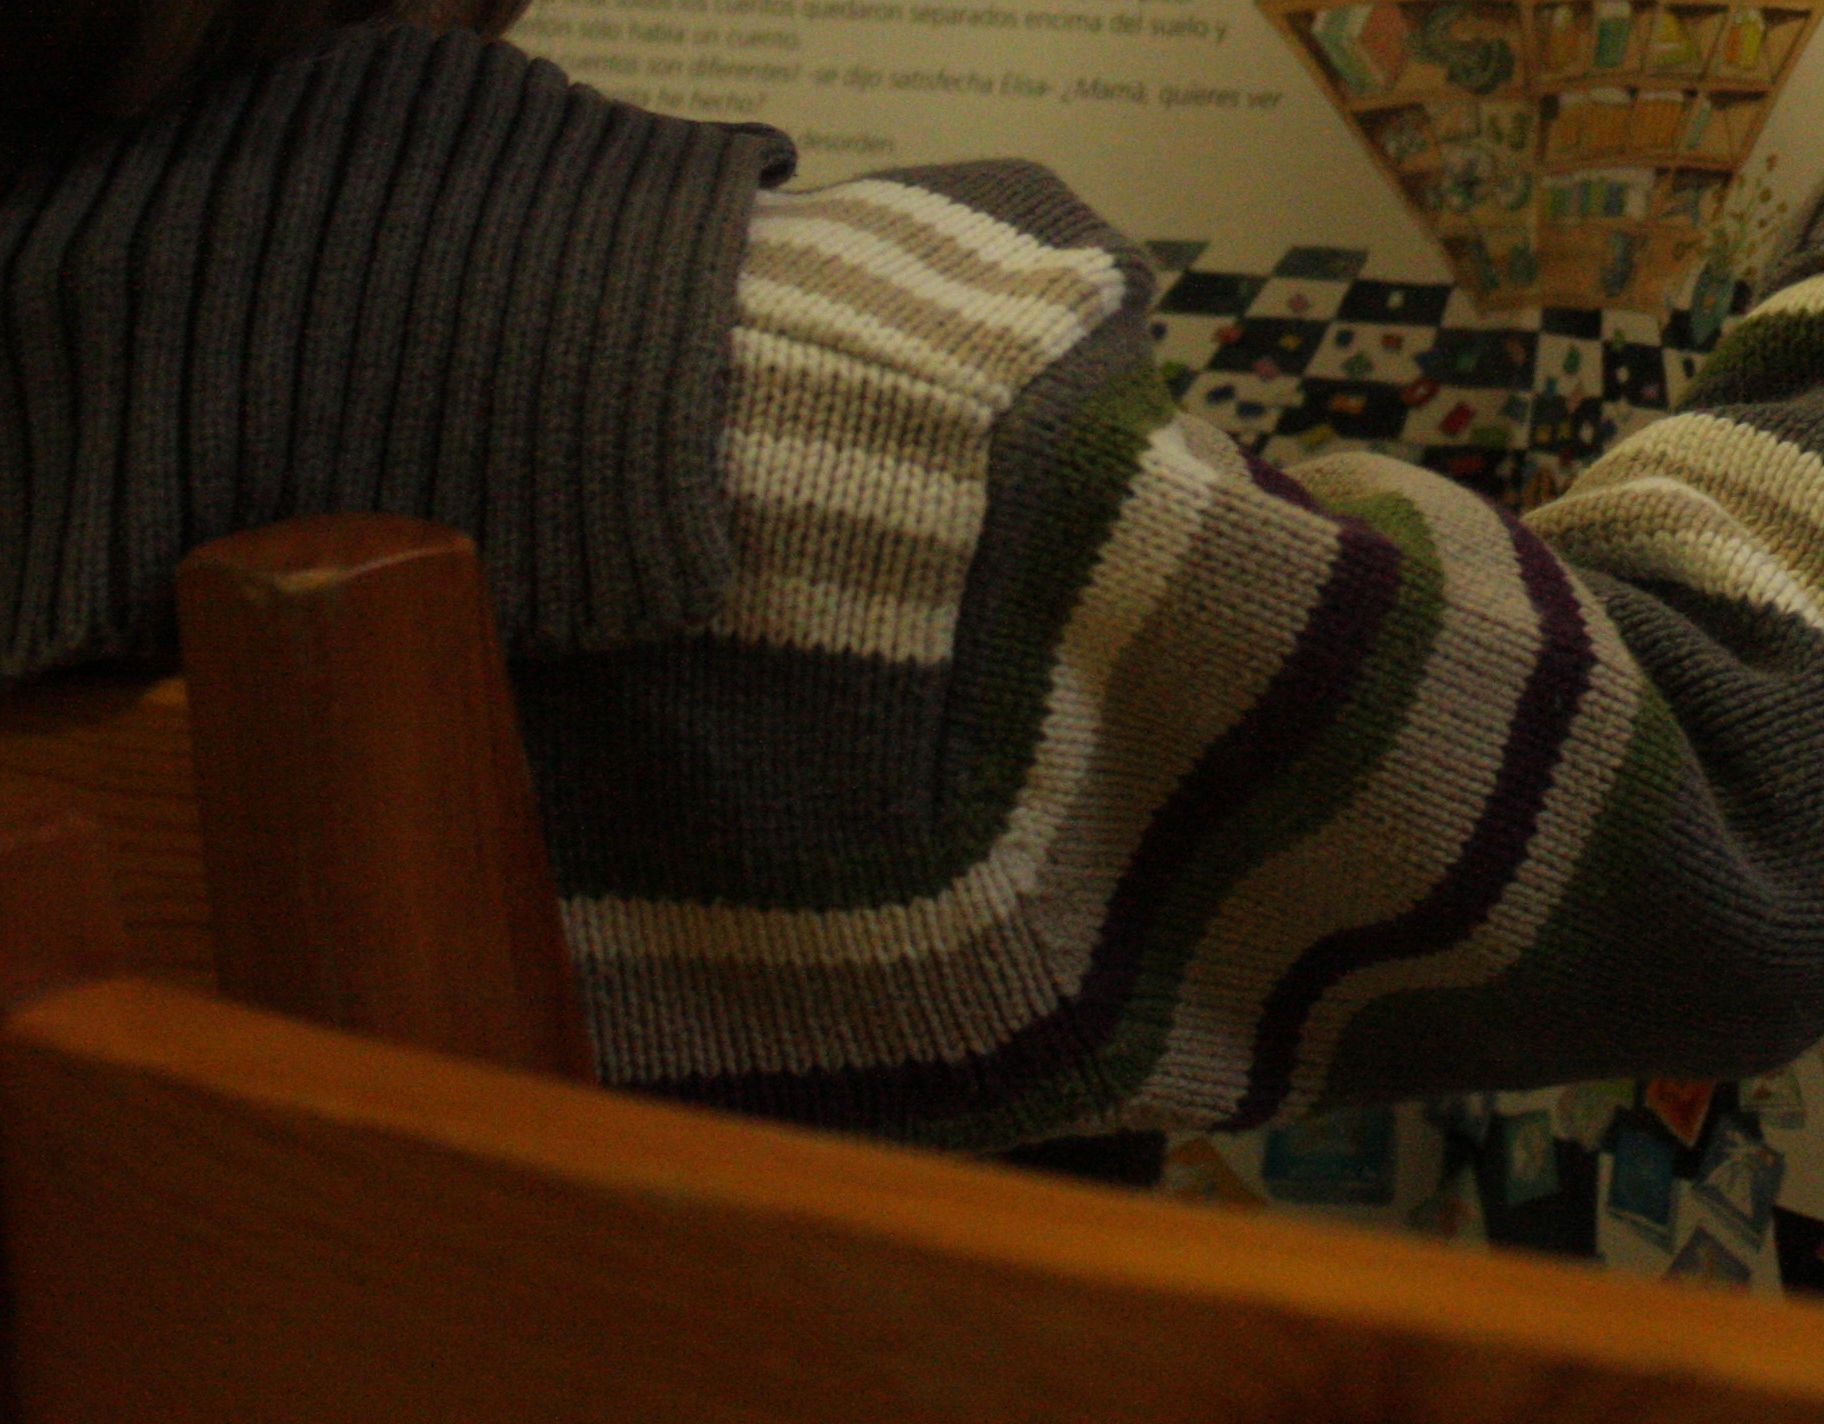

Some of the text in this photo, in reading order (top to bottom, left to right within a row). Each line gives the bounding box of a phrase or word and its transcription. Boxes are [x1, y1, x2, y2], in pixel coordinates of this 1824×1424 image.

[801, 0, 904, 24] quedaron
[910, 4, 1019, 30] separados
[1025, 11, 1104, 35] encima
[1109, 10, 1143, 35] del
[1150, 16, 1210, 39] suelo
[1214, 23, 1229, 45] y
[1158, 84, 1241, 111] quieres
[1246, 91, 1284, 111] ver
